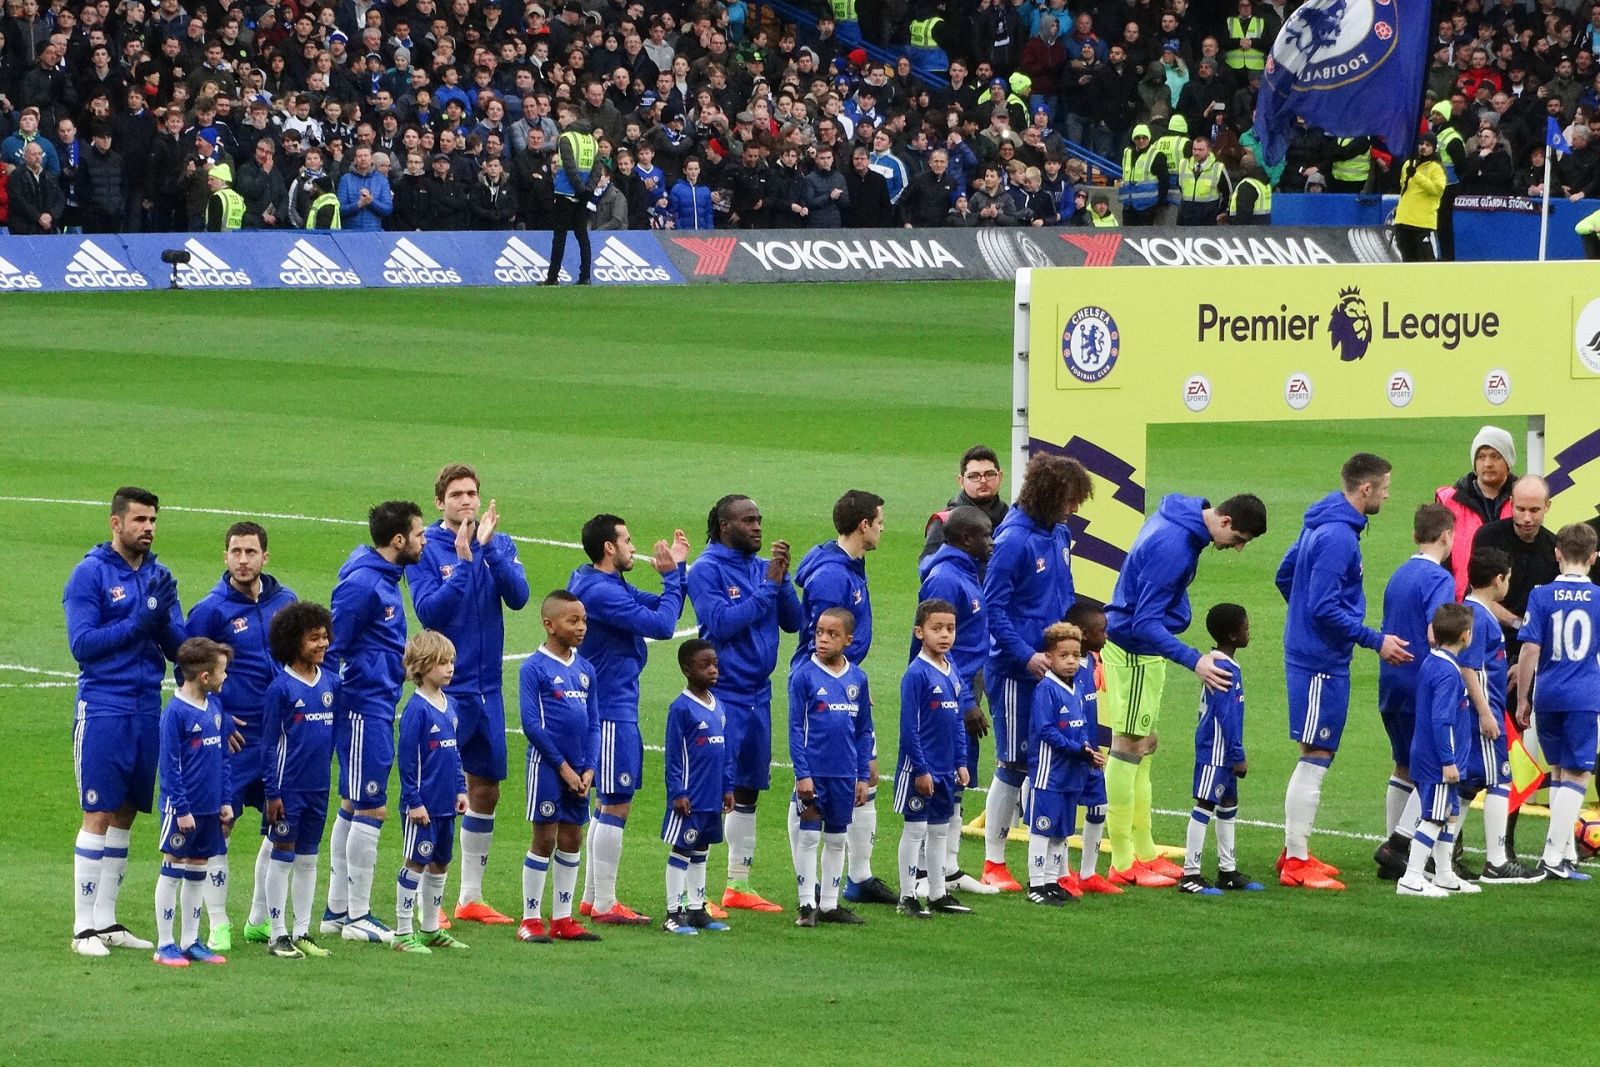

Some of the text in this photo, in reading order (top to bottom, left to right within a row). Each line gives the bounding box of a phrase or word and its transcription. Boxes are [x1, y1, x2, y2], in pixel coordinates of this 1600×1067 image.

[739, 239, 964, 271] YOKOHAMA
[1124, 237, 1337, 266] YOKOHAMA
[65, 269, 148, 288] adidas
[170, 268, 252, 286] adidas
[279, 267, 361, 286] adidas
[383, 266, 462, 284] adidas
[593, 265, 670, 282] adidas
[1071, 308, 1110, 325] CHELSEA
[1198, 301, 1499, 350] Premier League
[1187, 381, 1207, 394] EA
[1289, 379, 1308, 392] EA
[1391, 377, 1410, 391] EA
[1488, 375, 1507, 388] EA
[1487, 388, 1508, 396] SPORTS
[1554, 589, 1592, 601] ISAAC
[1550, 608, 1592, 662] 10
